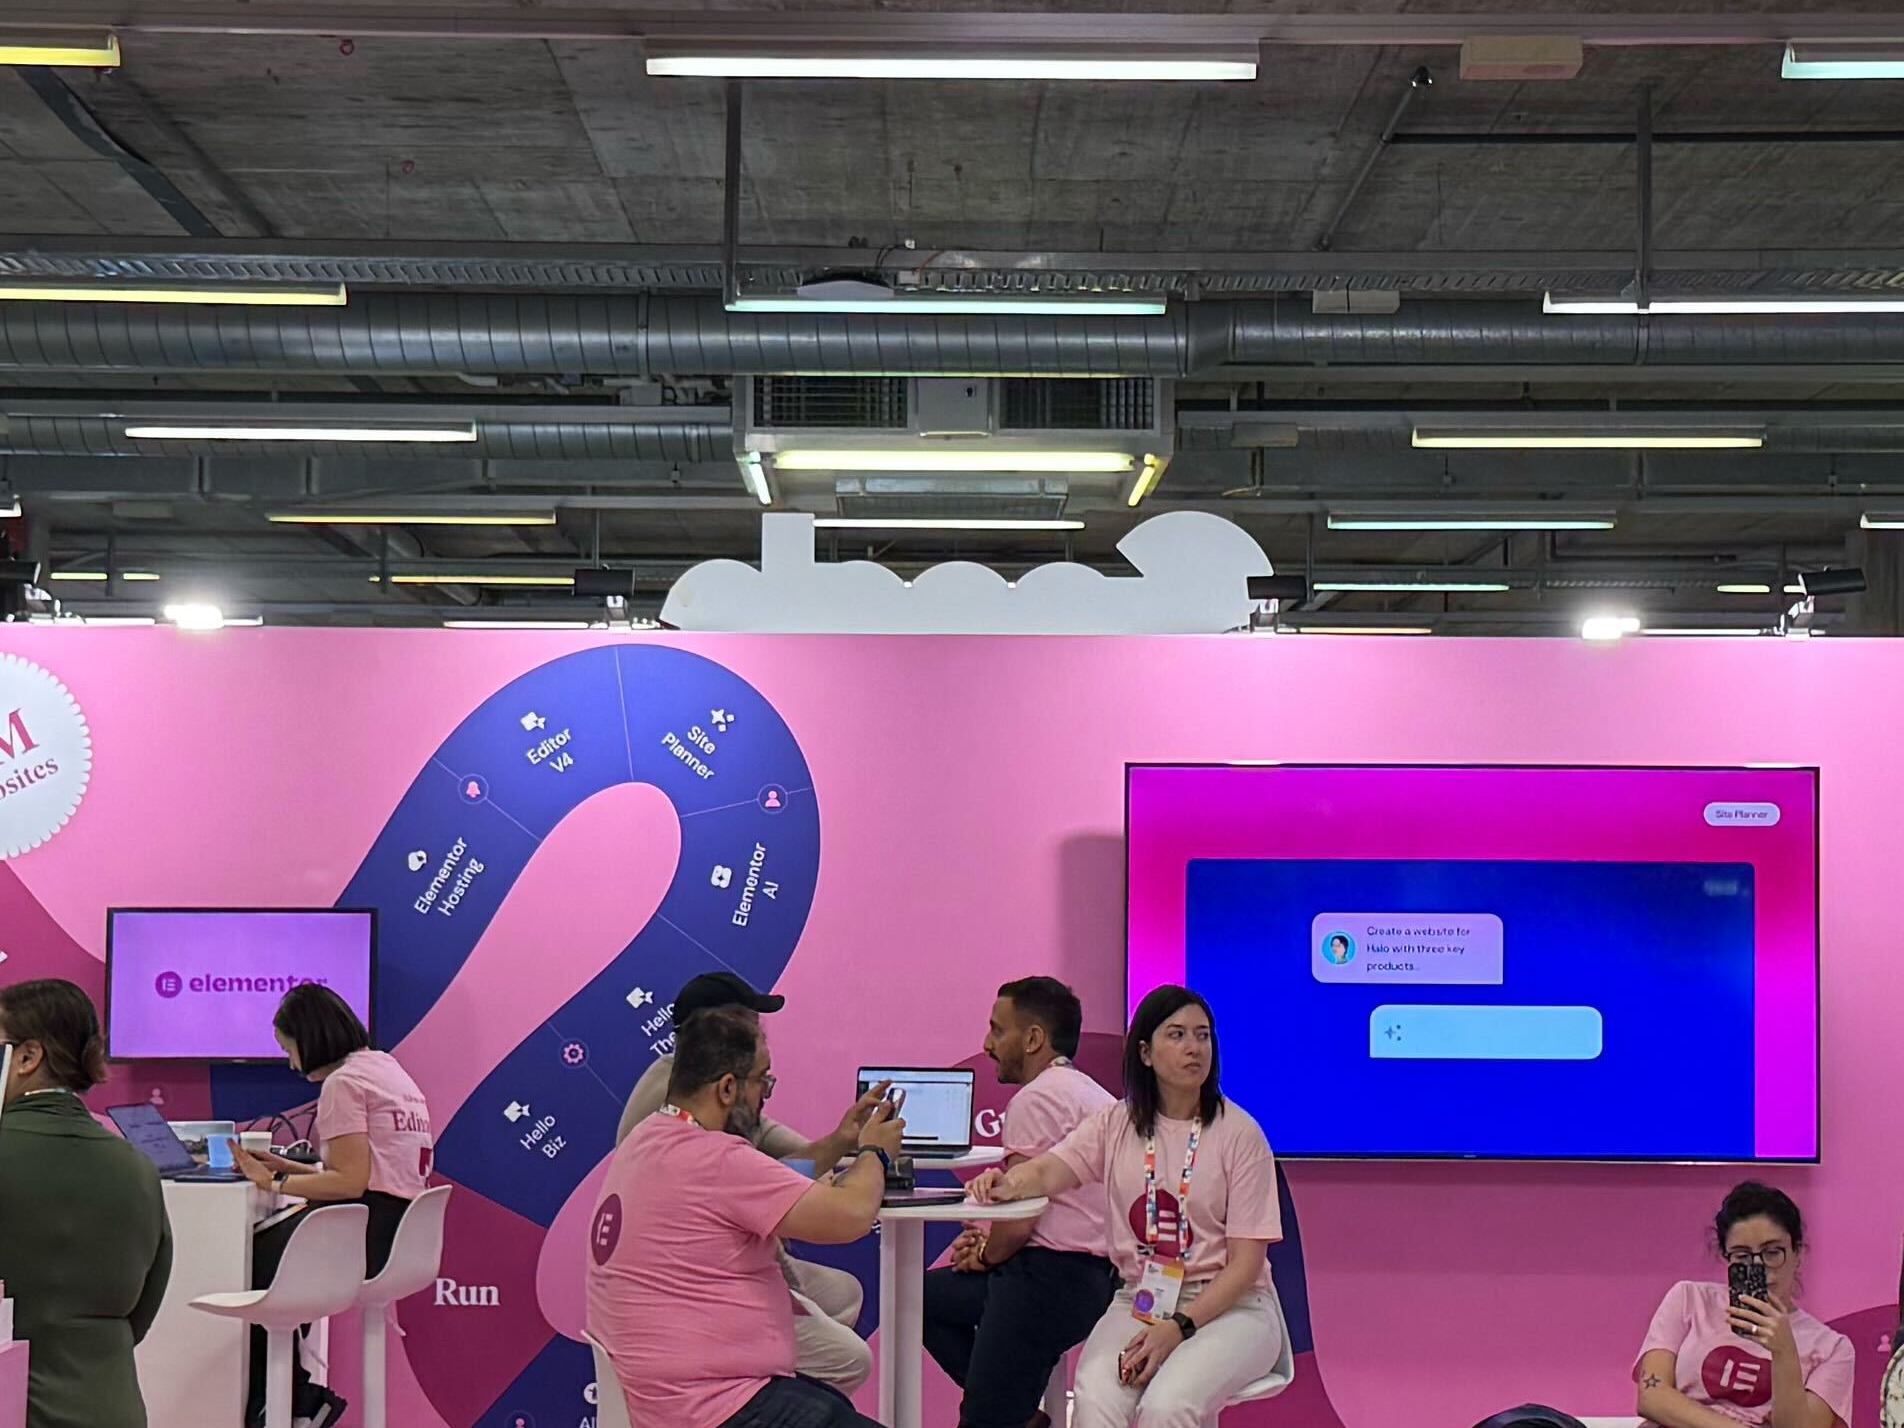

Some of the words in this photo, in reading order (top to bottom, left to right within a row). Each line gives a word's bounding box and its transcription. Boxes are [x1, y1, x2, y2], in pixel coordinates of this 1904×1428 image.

[526, 728, 572, 765] Editor
[661, 732, 714, 779] Planner
[687, 725, 716, 755] Site
[550, 754, 575, 773] V4
[414, 836, 468, 915] Elementor
[438, 857, 485, 916] Hosting
[732, 842, 767, 927] Elementor
[520, 1115, 556, 1150] Hello
[542, 1135, 567, 1159] Biz
[434, 1278, 500, 1306] Run
